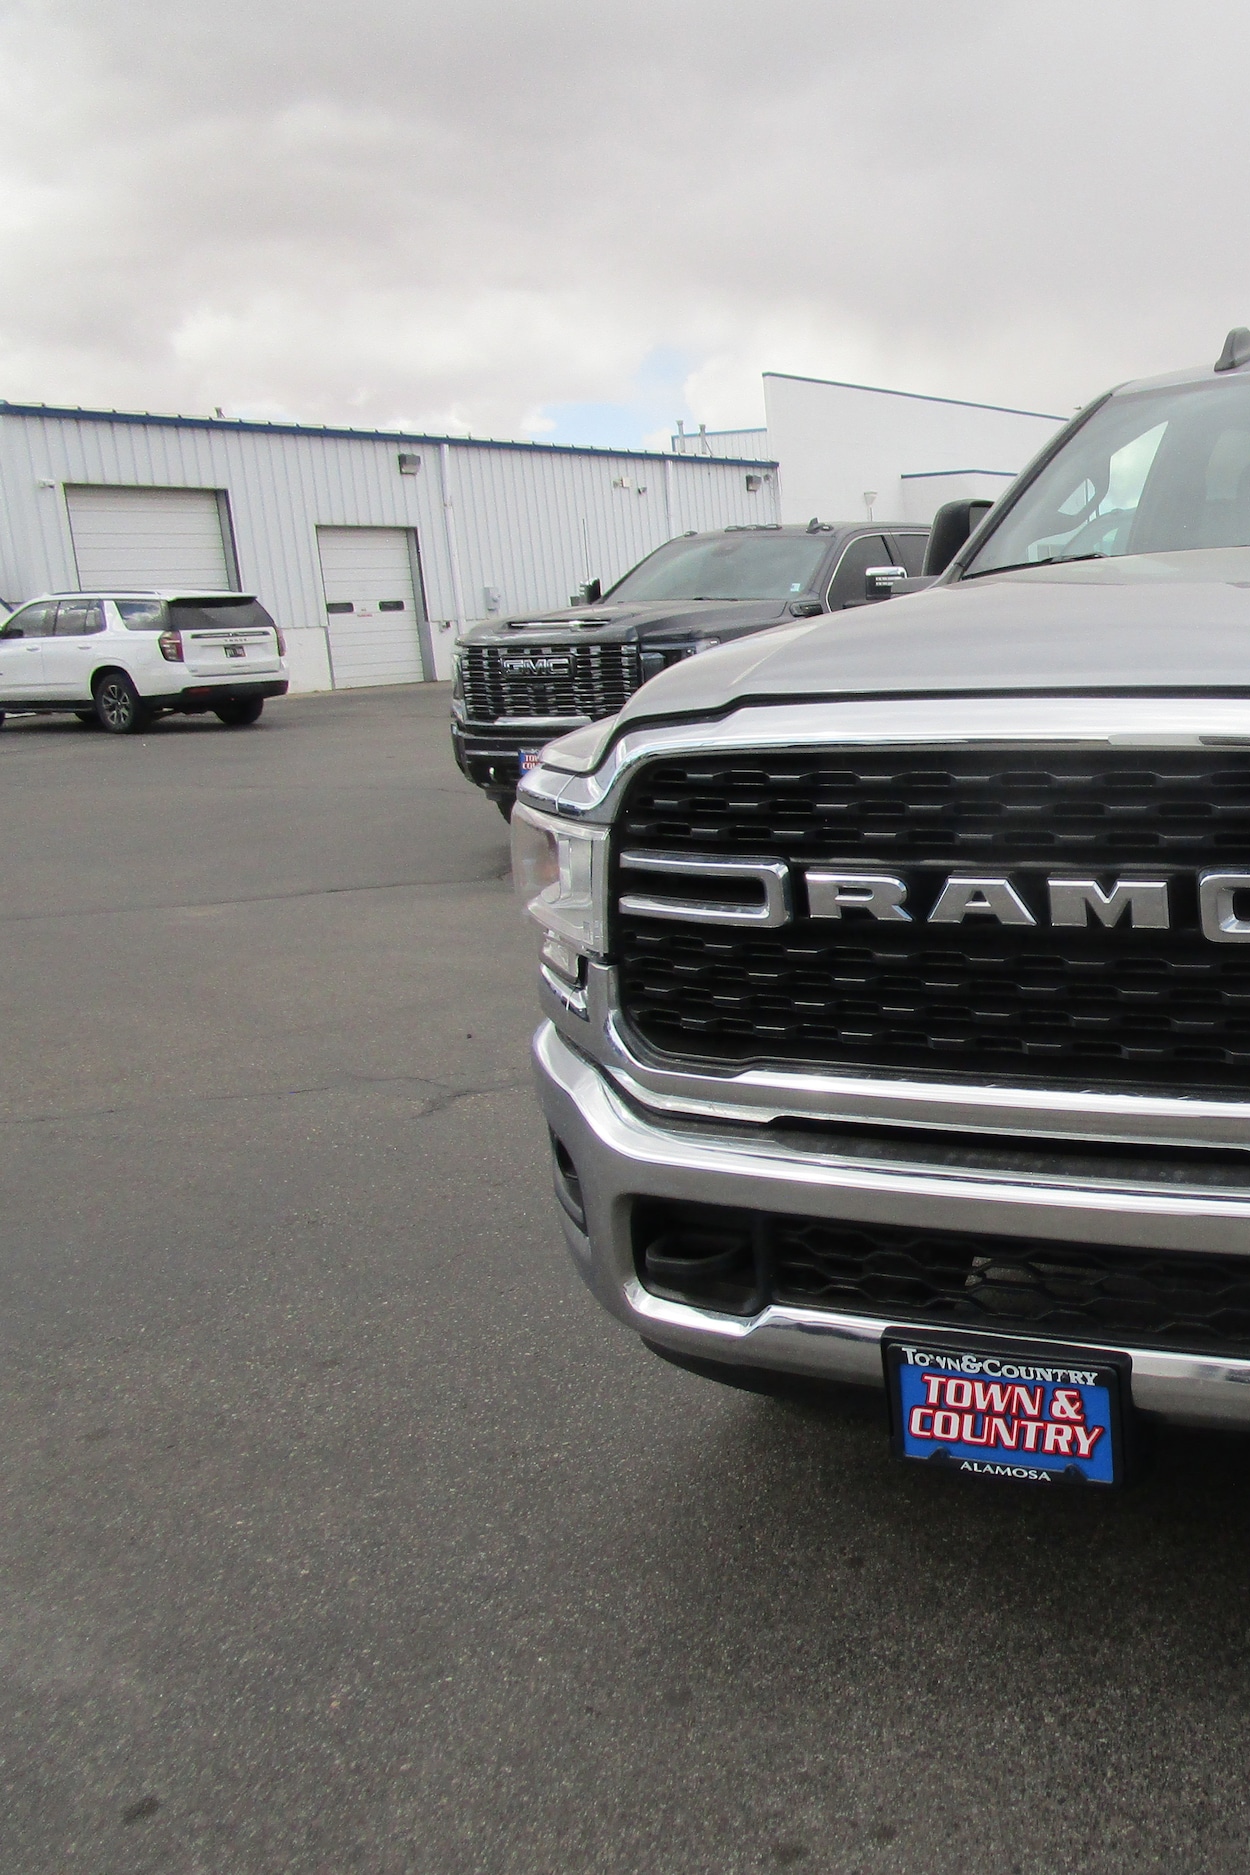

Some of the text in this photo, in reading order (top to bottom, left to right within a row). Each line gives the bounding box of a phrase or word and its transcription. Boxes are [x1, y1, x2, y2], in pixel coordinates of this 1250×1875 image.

[503, 658, 569, 675] GMC
[804, 871, 1170, 928] RAM
[921, 1373, 1085, 1422] TOWN &
[908, 1405, 1105, 1459] COUNTRY
[960, 1461, 1051, 1481] ALAMOSA
